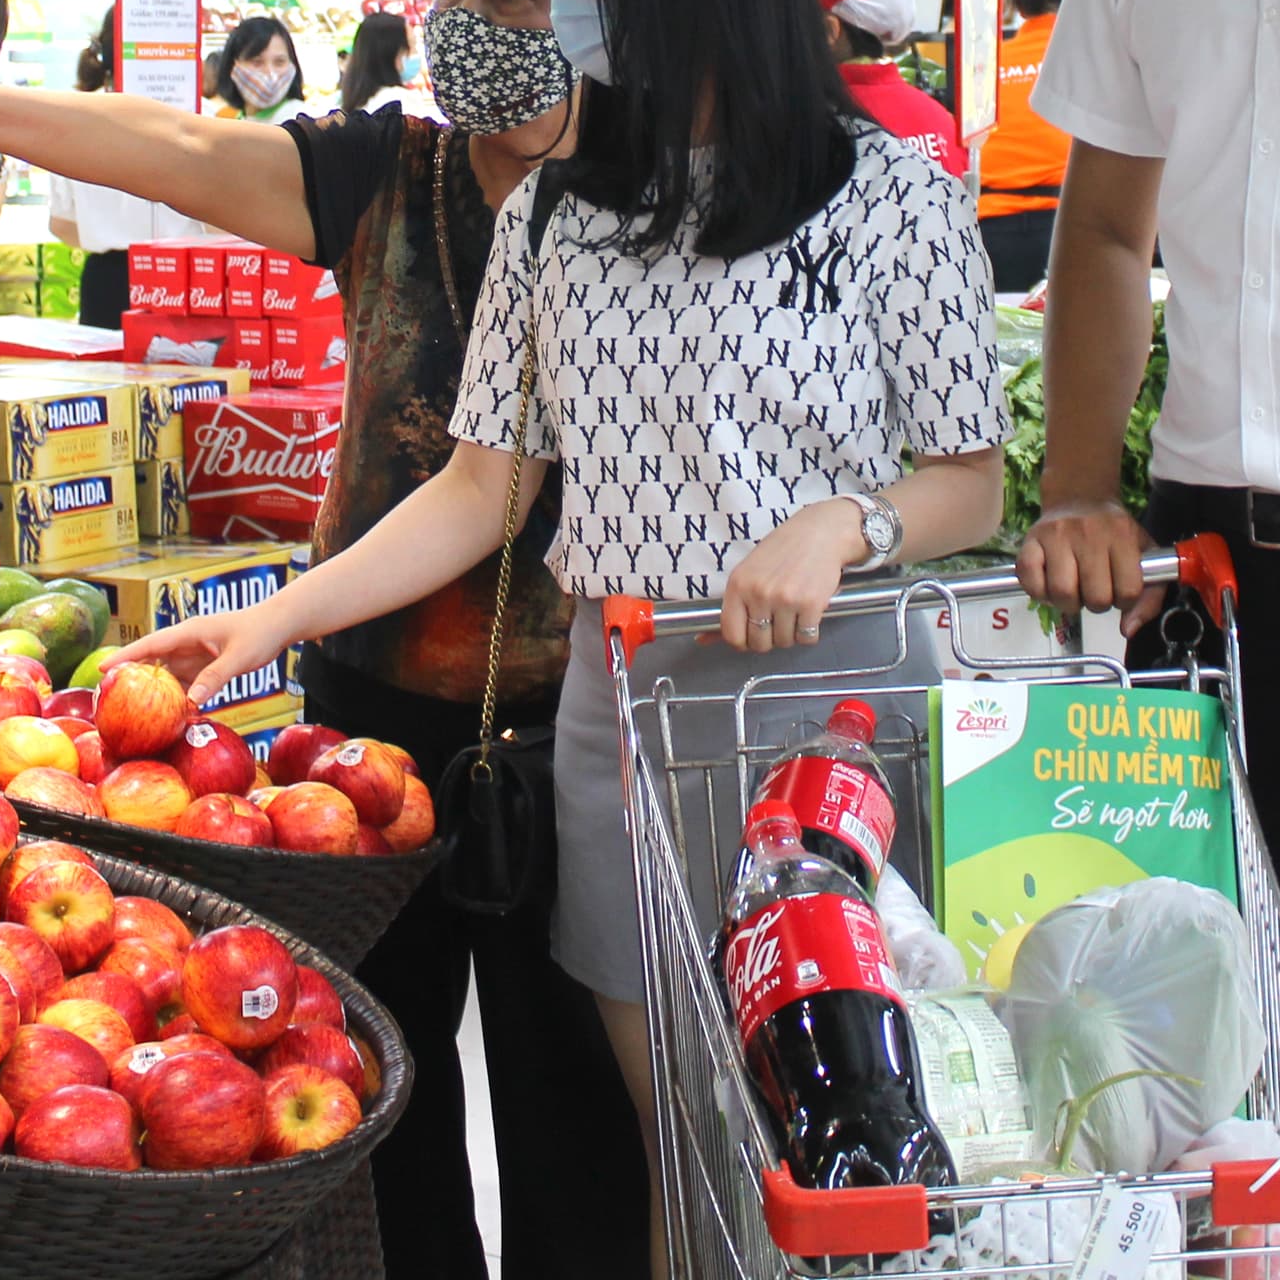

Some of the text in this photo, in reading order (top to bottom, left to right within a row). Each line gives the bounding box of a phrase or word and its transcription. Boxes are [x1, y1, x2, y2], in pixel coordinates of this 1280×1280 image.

[130, 285, 153, 304] Bu
[152, 287, 185, 308] Bud
[190, 287, 223, 309] Bud
[263, 288, 297, 311] Bud
[271, 359, 305, 380] Bud
[47, 401, 101, 429] HALIDA
[53, 481, 107, 511] HALIDA
[199, 660, 280, 709] ALIDA
[956, 710, 1008, 731] Zespri
[1067, 696, 1200, 742] QUẢ KIWI
[1034, 737, 1221, 790] CHÍN MỀM TAY
[1051, 786, 1212, 843] Sẽ ngọt hơn
[1118, 1201, 1145, 1253] 45.500
